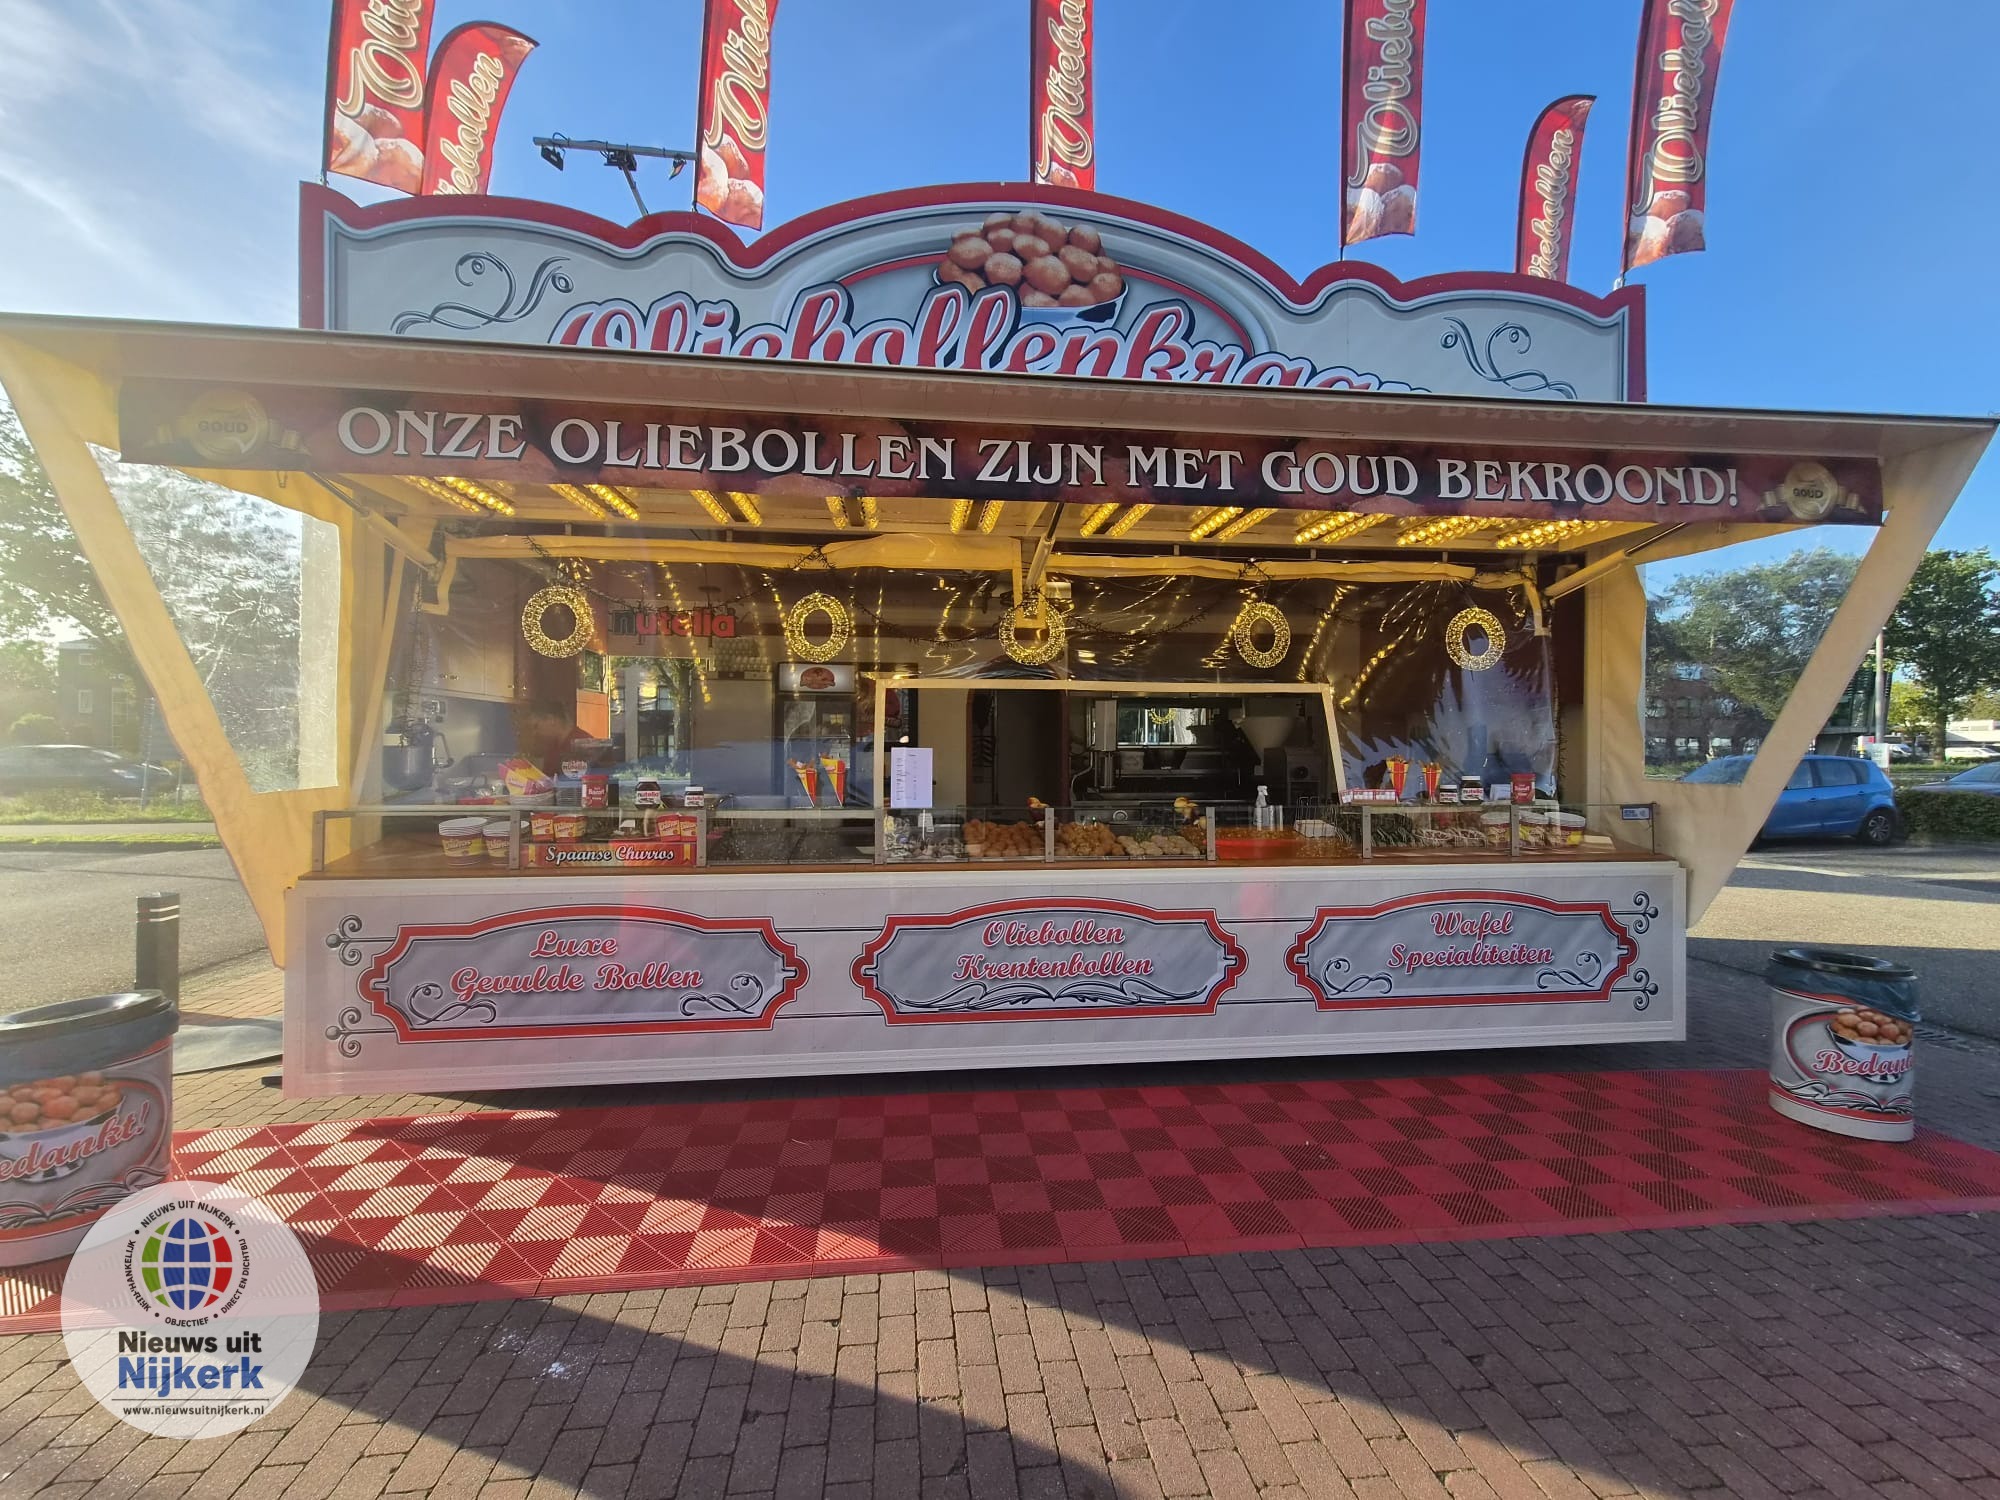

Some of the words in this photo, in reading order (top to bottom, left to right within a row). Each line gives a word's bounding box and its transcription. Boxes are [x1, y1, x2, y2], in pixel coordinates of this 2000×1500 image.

[338, 407, 528, 460] ONZE
[551, 419, 957, 481] OLIEBOLLEN
[976, 439, 1106, 486] ZIJN
[1126, 445, 1243, 490] MET
[1261, 451, 1418, 497] GOUD
[1437, 458, 1737, 507] BEKROOND!
[1792, 487, 1824, 499] GOUD
[546, 846, 612, 866] Spaanse
[615, 845, 675, 862] Churros
[982, 919, 1125, 947] Oliebollen
[1430, 911, 1513, 944] Wafel
[530, 930, 618, 959] Luxe
[1387, 942, 1554, 974] Specialiteiten
[952, 952, 1153, 981] Krentenbollen
[450, 964, 585, 1002] Gevulde
[593, 961, 703, 992] Bollen
